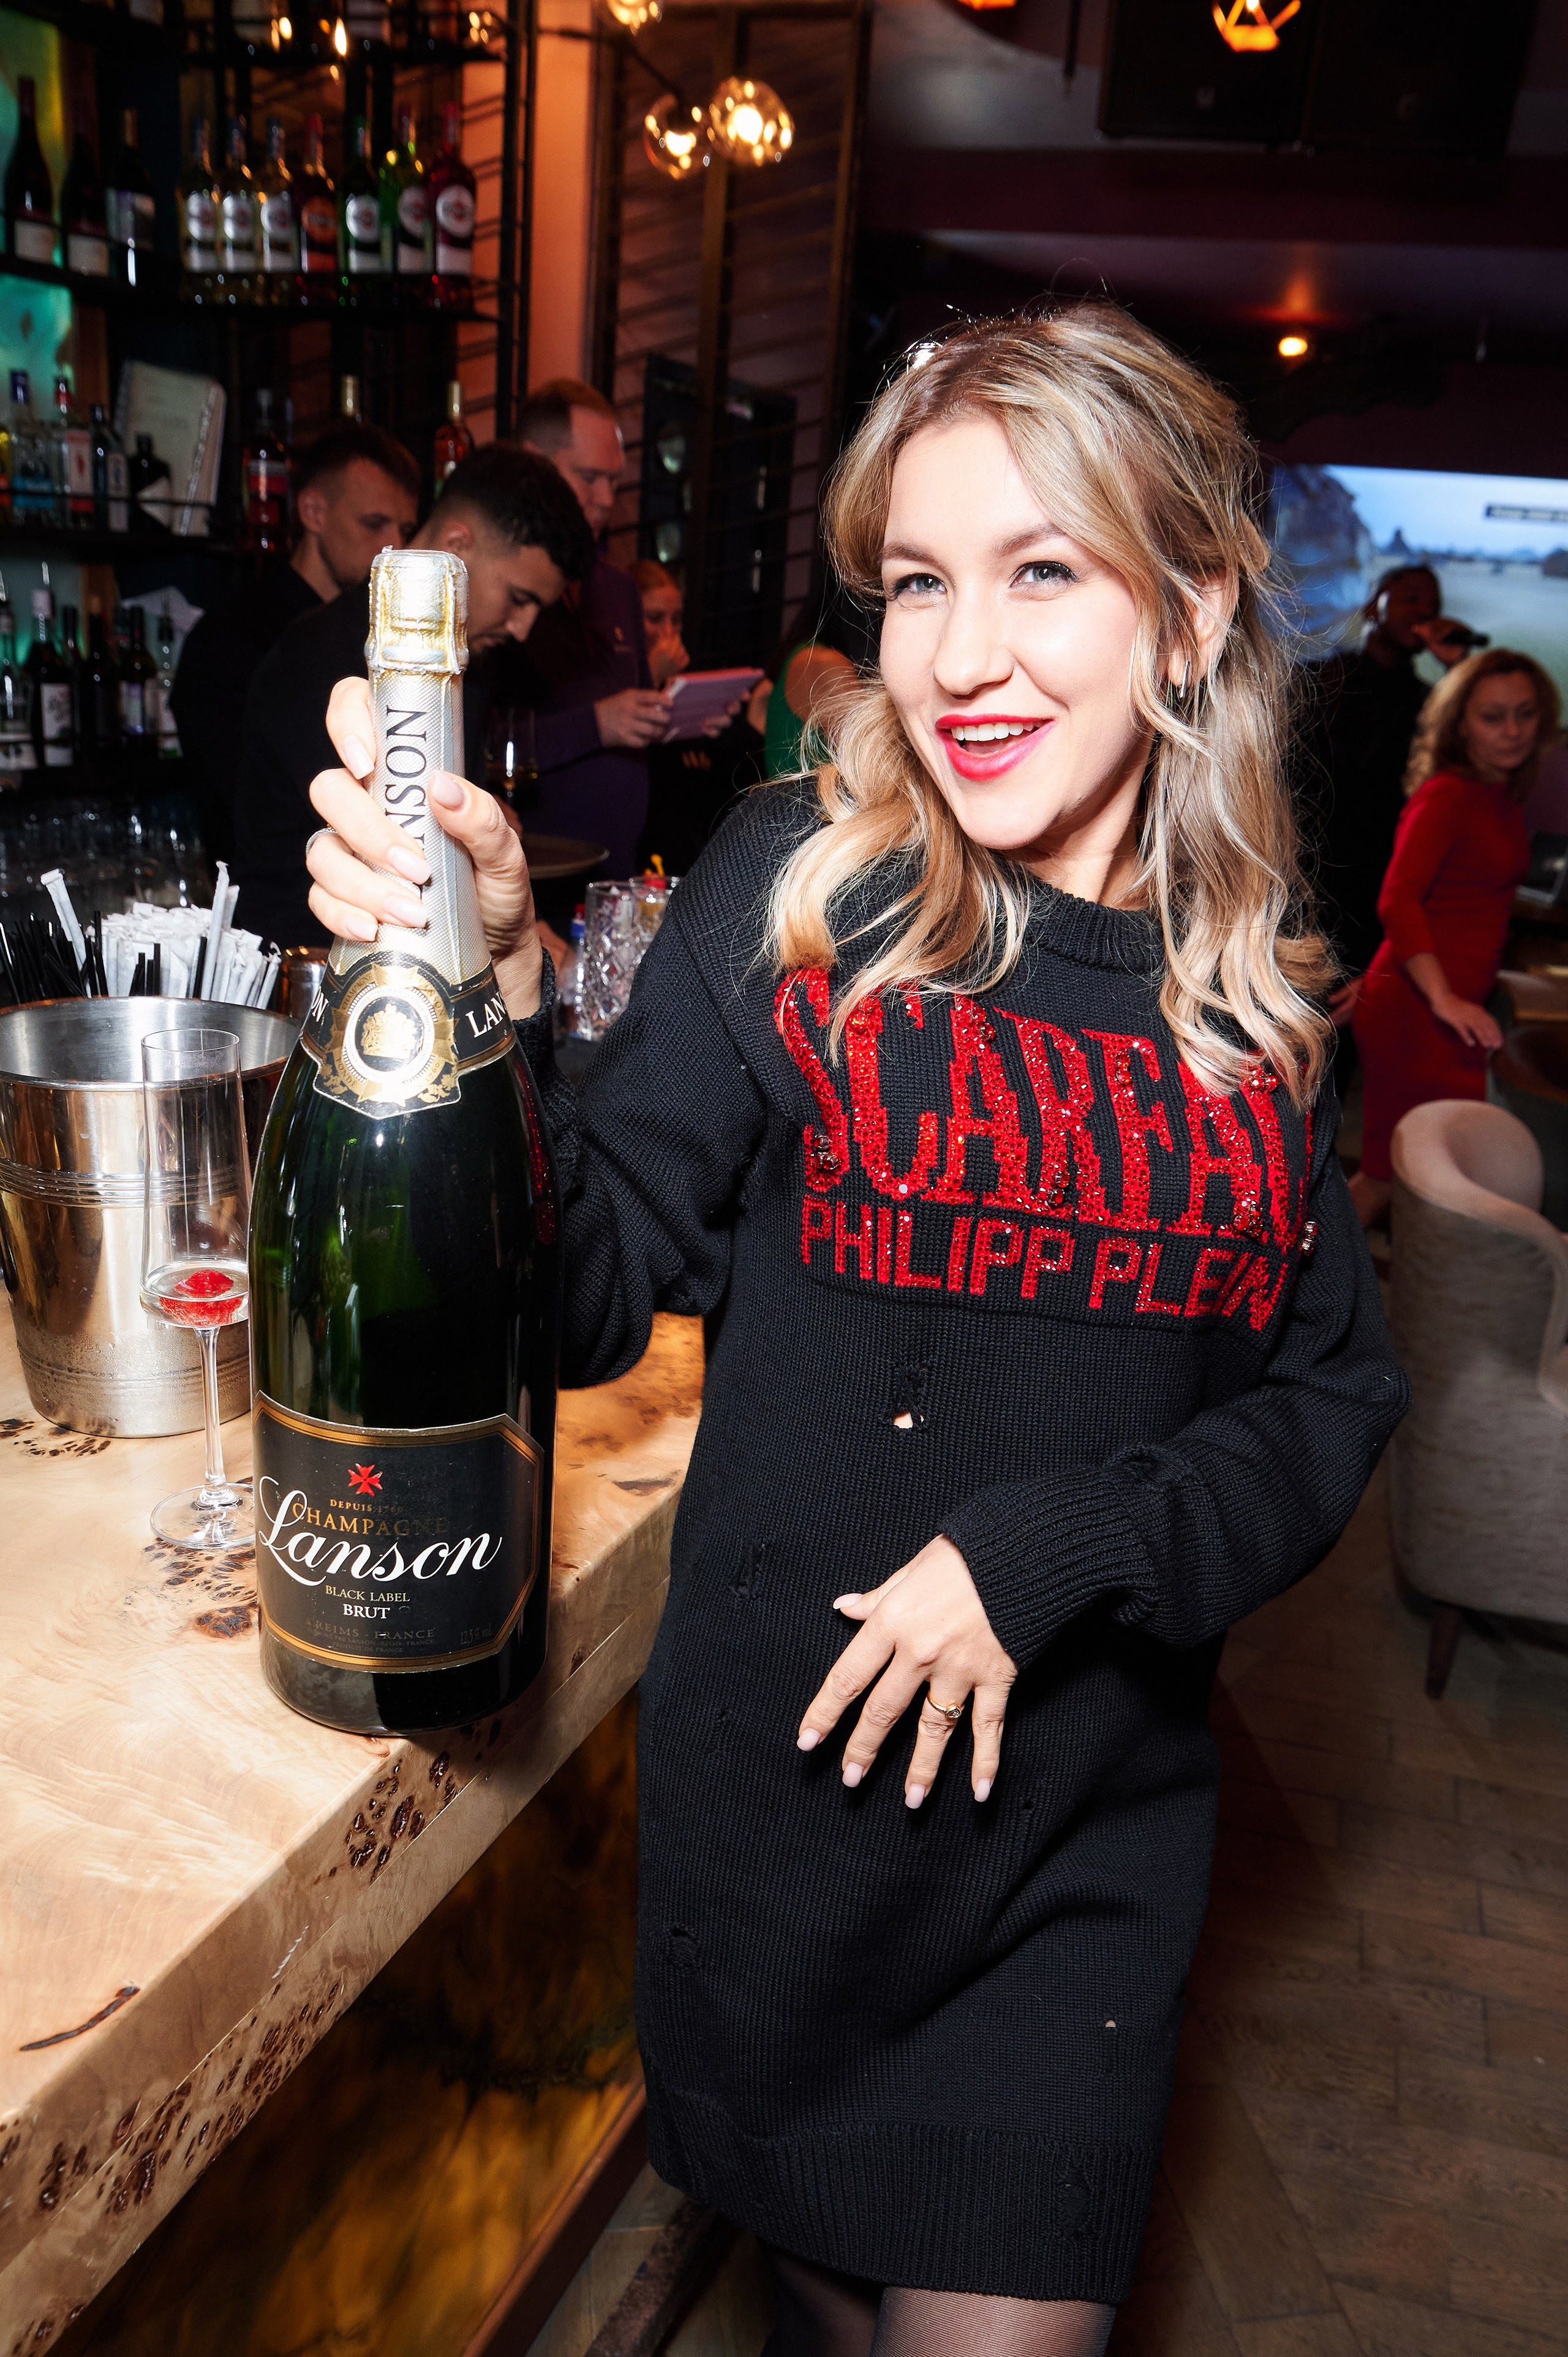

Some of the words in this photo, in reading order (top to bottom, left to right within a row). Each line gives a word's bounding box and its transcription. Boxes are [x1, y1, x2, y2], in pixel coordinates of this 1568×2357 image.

[801, 1195, 1073, 1299] PHILIPP
[1089, 1238, 1289, 1333] PLEIN
[330, 1499, 372, 1512] DEPUIS
[292, 1502, 448, 1537] CHAMPAGNE
[258, 1475, 502, 1587] Lanson
[325, 1584, 366, 1601] BLACK
[369, 1591, 411, 1602] LABEL
[343, 1603, 391, 1619] BRUT
[314, 1621, 359, 1638] REIMS
[374, 1629, 436, 1640] FRANCE
